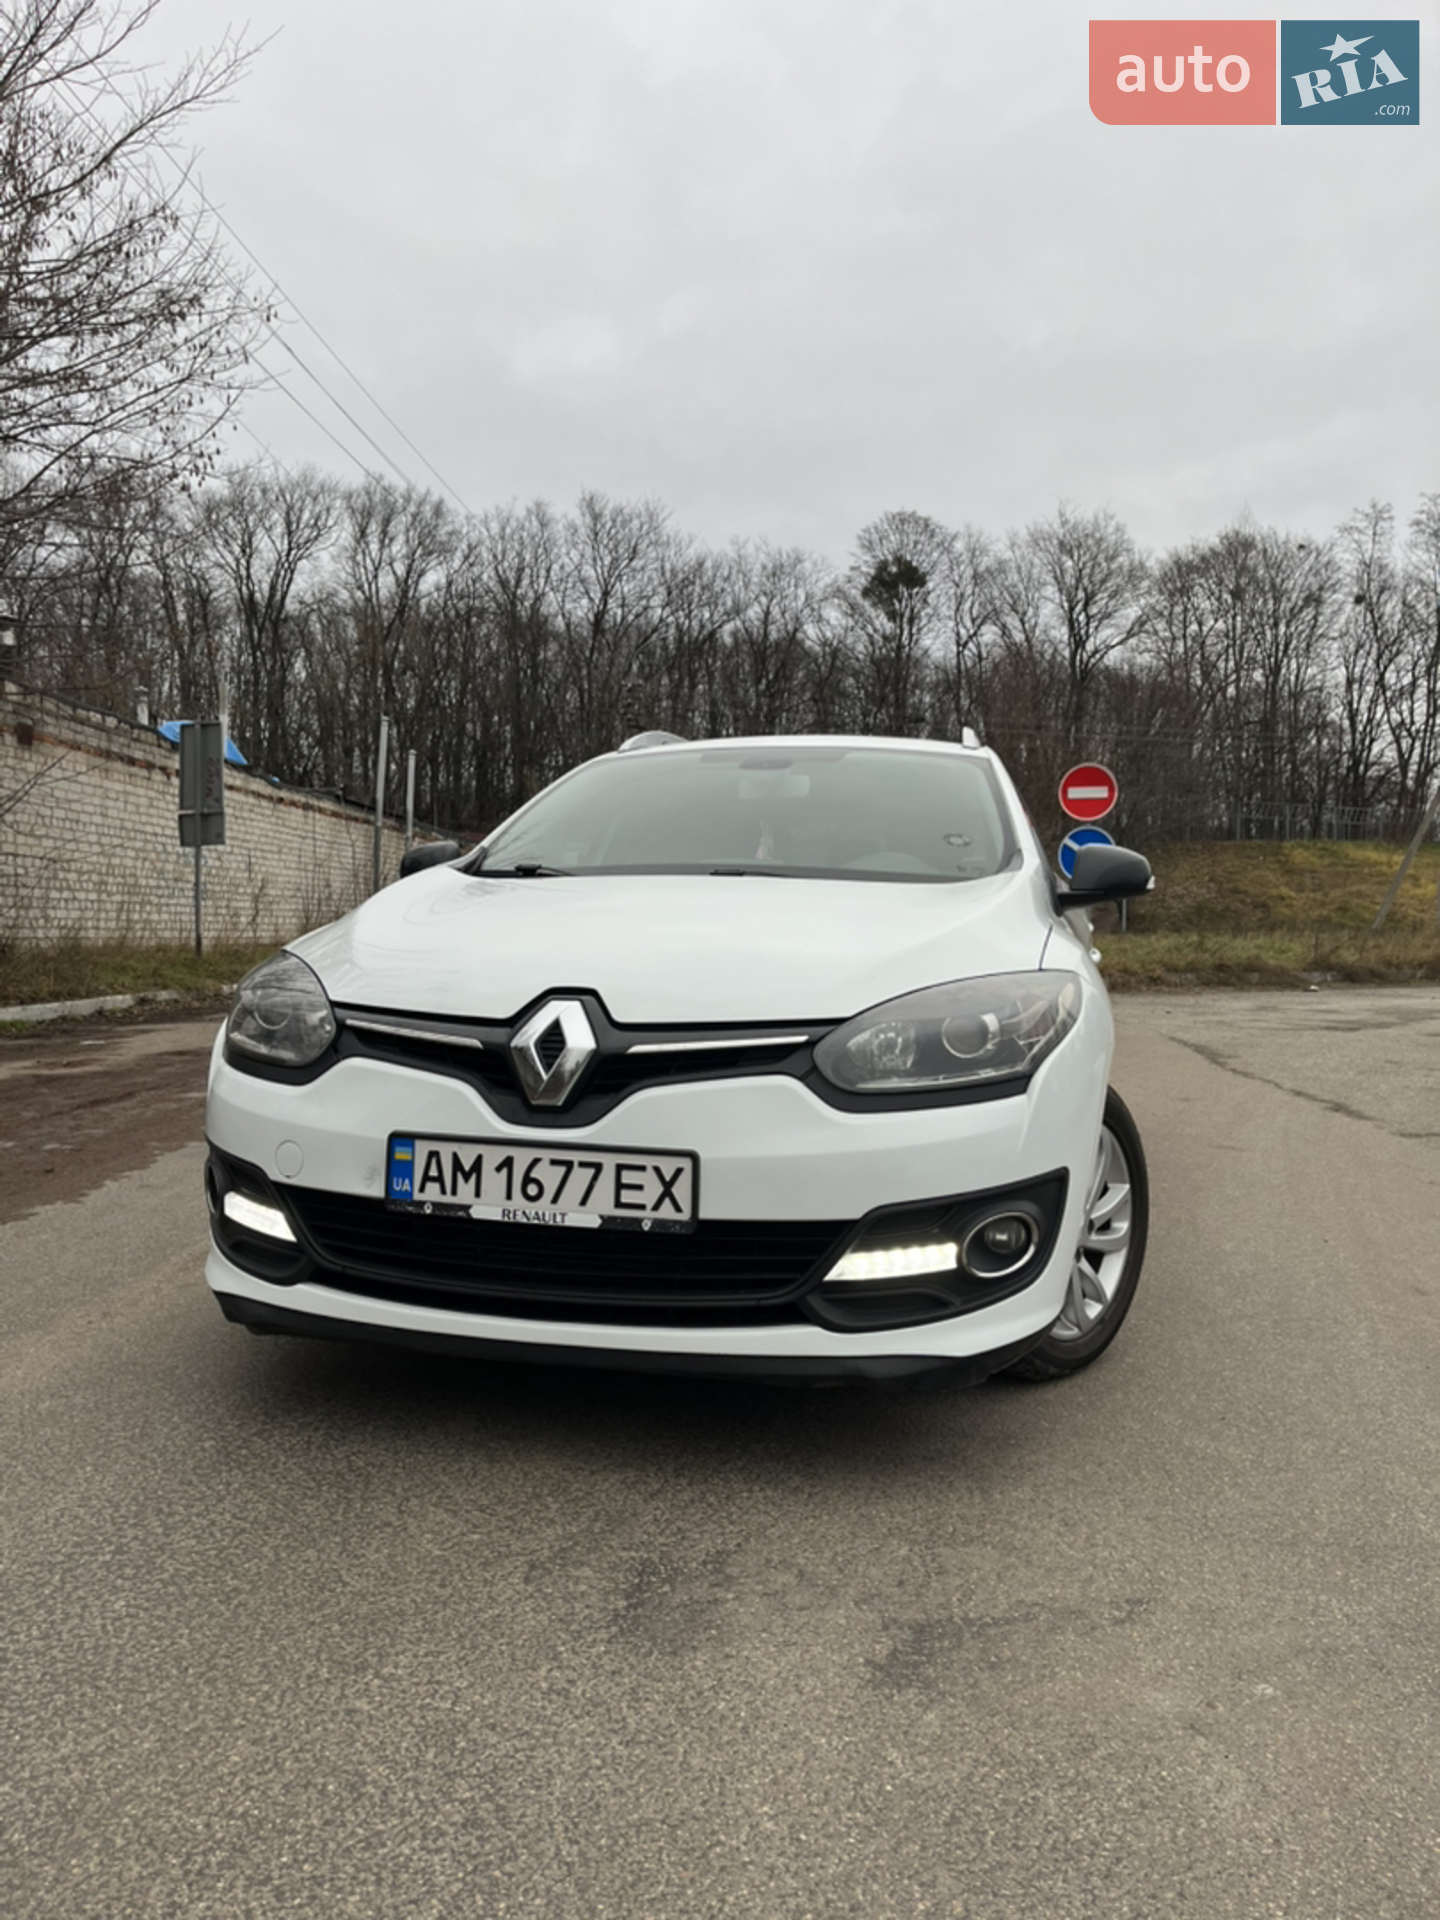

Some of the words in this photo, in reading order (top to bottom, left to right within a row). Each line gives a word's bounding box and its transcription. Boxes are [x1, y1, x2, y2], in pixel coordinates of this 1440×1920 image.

[393, 1176, 412, 1193] UA
[418, 1150, 483, 1199] AM
[494, 1155, 603, 1207] 1677
[614, 1163, 685, 1214] EX
[501, 1208, 568, 1226] RENAULT
